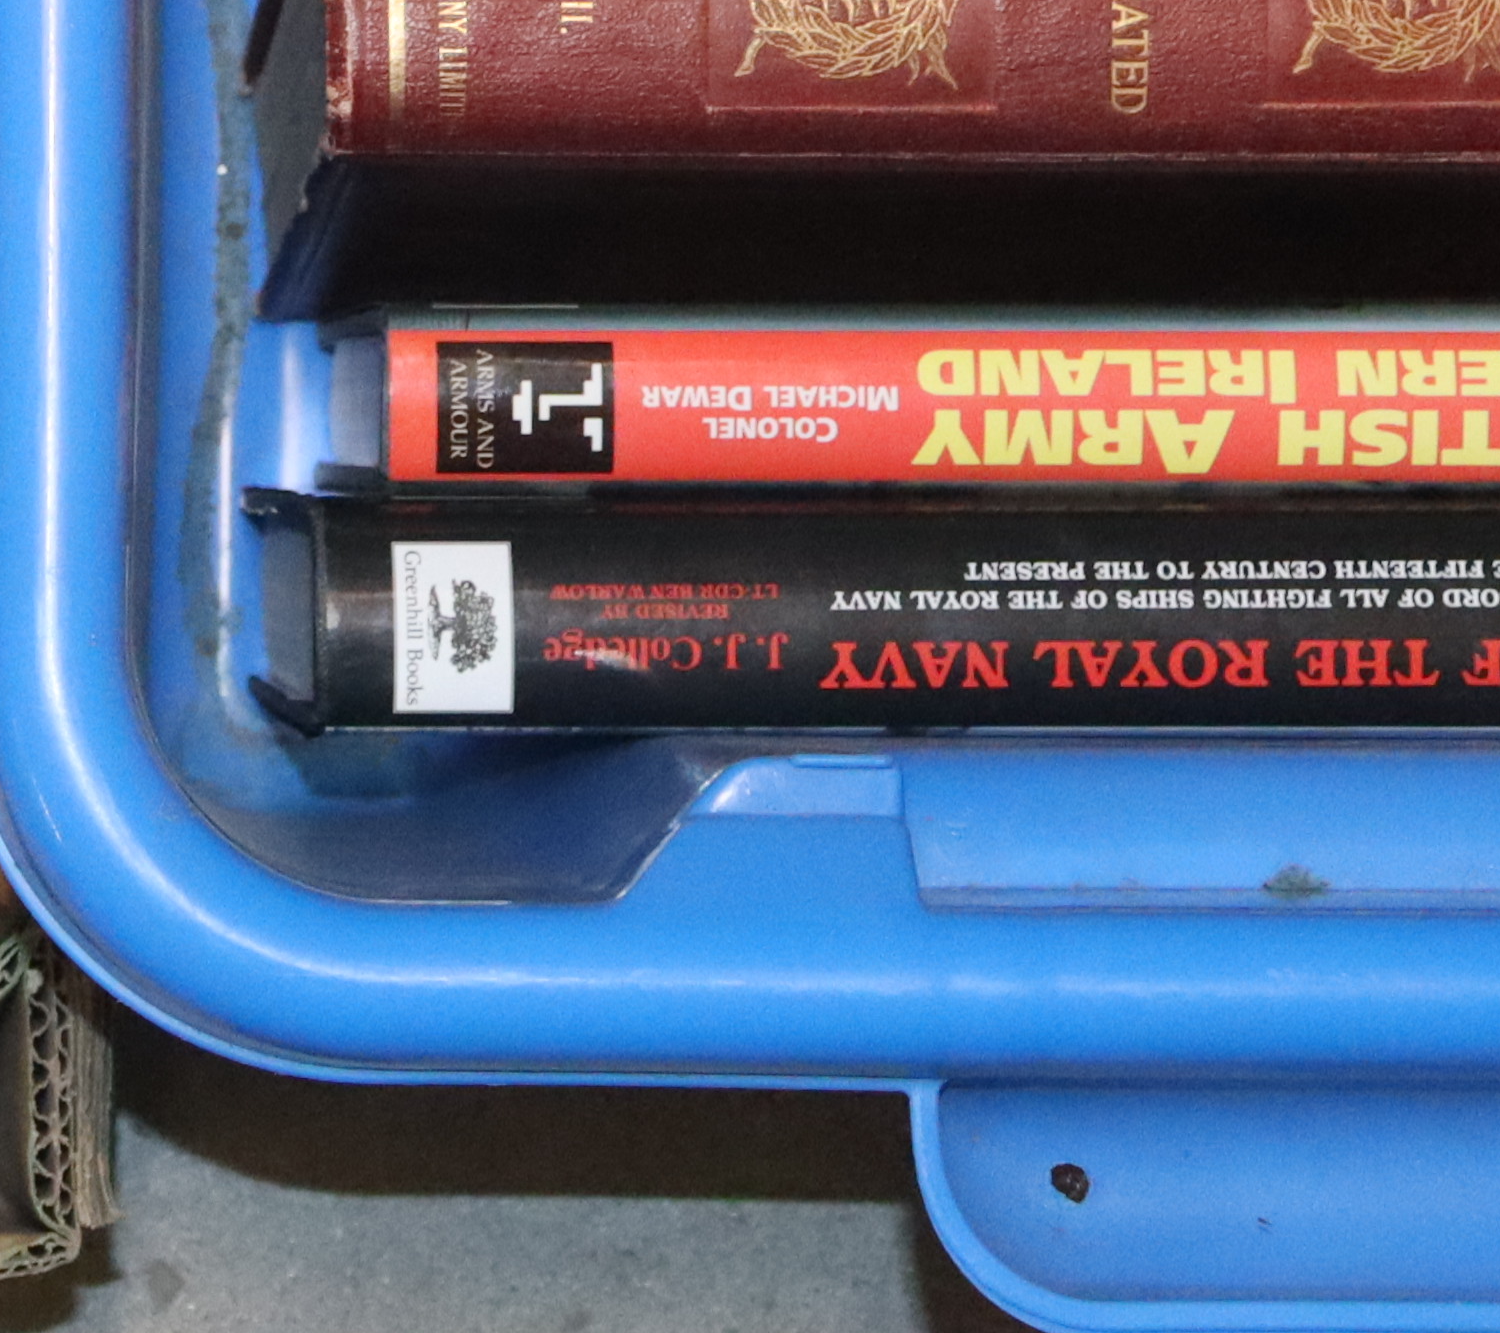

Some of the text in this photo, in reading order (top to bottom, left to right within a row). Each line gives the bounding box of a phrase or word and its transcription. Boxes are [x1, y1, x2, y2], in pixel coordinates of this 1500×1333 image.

[919, 351, 1295, 402] IRELAND
[643, 386, 897, 410] MICHAEL DEWAR
[704, 418, 837, 441] COLONEL
[914, 410, 1233, 472] ARMY
[965, 563, 1084, 580] PRESENT
[1094, 562, 1149, 579] THE
[1157, 561, 1194, 580] TO
[1203, 561, 1325, 578] CENTURY
[1335, 561, 1483, 578] FIFTEENTH
[831, 591, 901, 610] NAVY
[910, 591, 998, 609] ROYAL
[1008, 591, 1062, 609] THE
[1071, 590, 1107, 609] OF
[1117, 590, 1193, 608] SHIPS
[1204, 590, 1331, 608] FIGHTING
[1340, 589, 1389, 608] ALL
[1398, 589, 1433, 607] OF
[404, 550, 423, 705] Greenhill Books
[821, 642, 1007, 688] NAVY
[1036, 641, 1267, 686] ROYAL
[1297, 640, 1437, 685] THE
